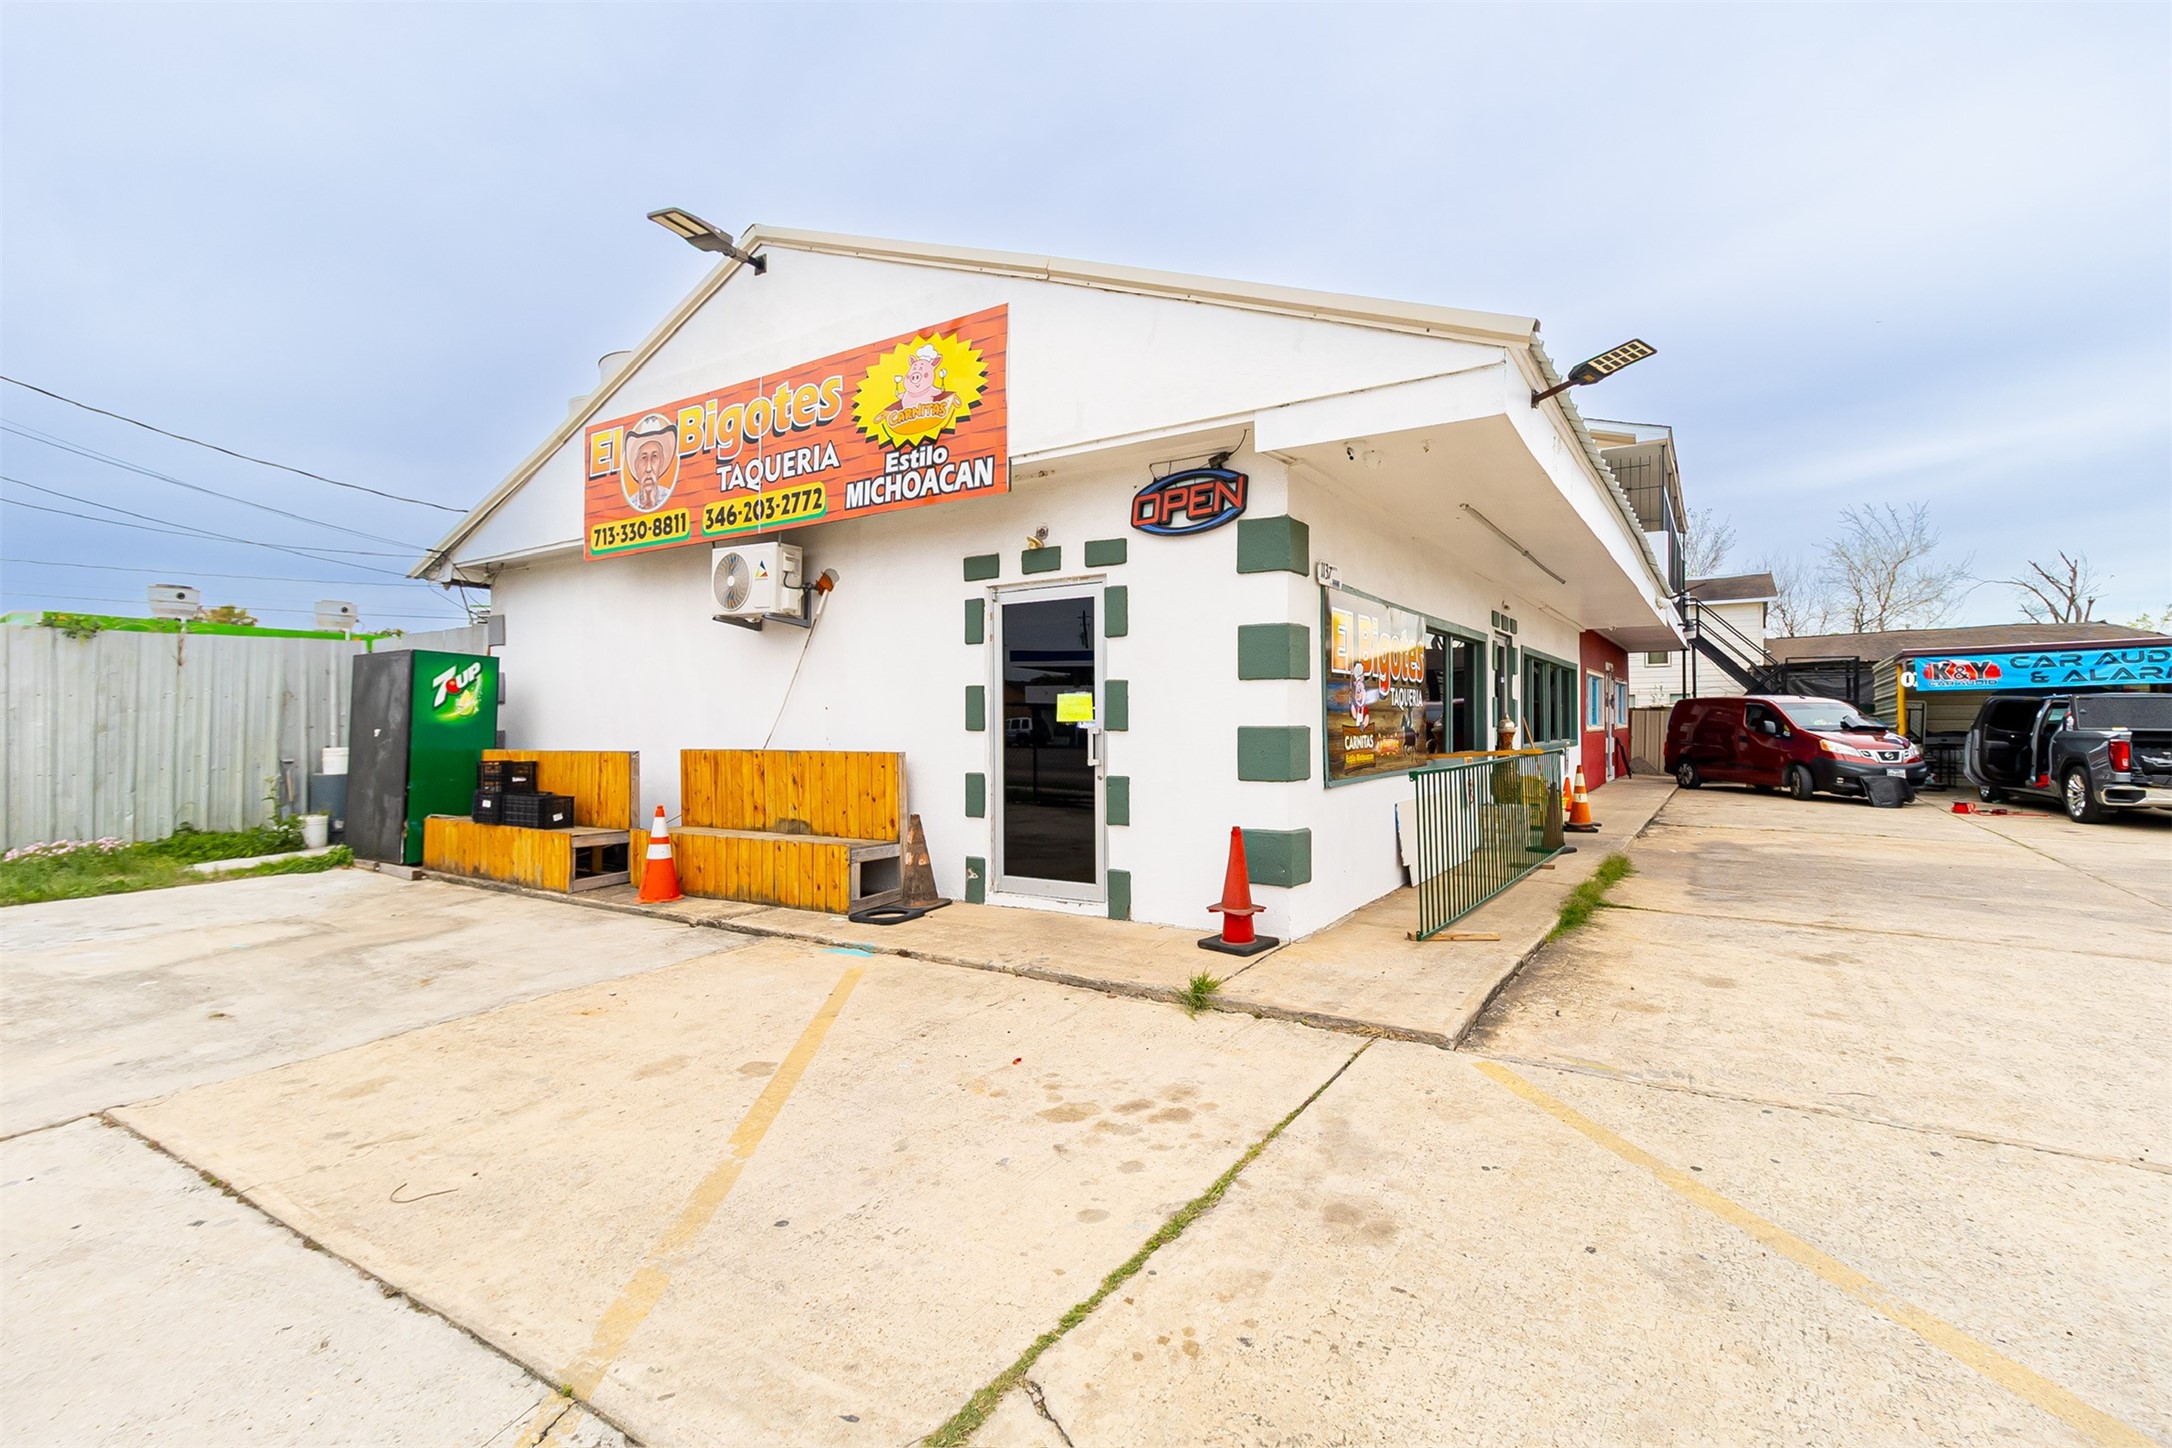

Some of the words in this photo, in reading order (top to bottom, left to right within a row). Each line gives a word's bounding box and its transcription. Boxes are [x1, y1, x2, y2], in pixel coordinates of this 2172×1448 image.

[589, 426, 624, 479] El
[676, 375, 843, 463] Bigotes
[888, 401, 947, 426] CARNITAS
[716, 440, 841, 492] TAQUERIA
[885, 445, 949, 474] Estilo
[845, 456, 995, 510] MICHOACAN
[1132, 475, 1245, 527] OPEN
[1357, 613, 1425, 697] Bigotes
[2010, 653, 2083, 669] CAR
[2094, 649, 2171, 666] AUD
[2030, 671, 2050, 683] &
[1390, 687, 1423, 711] TAQUERIA
[1344, 734, 1374, 751] CARNITAS
